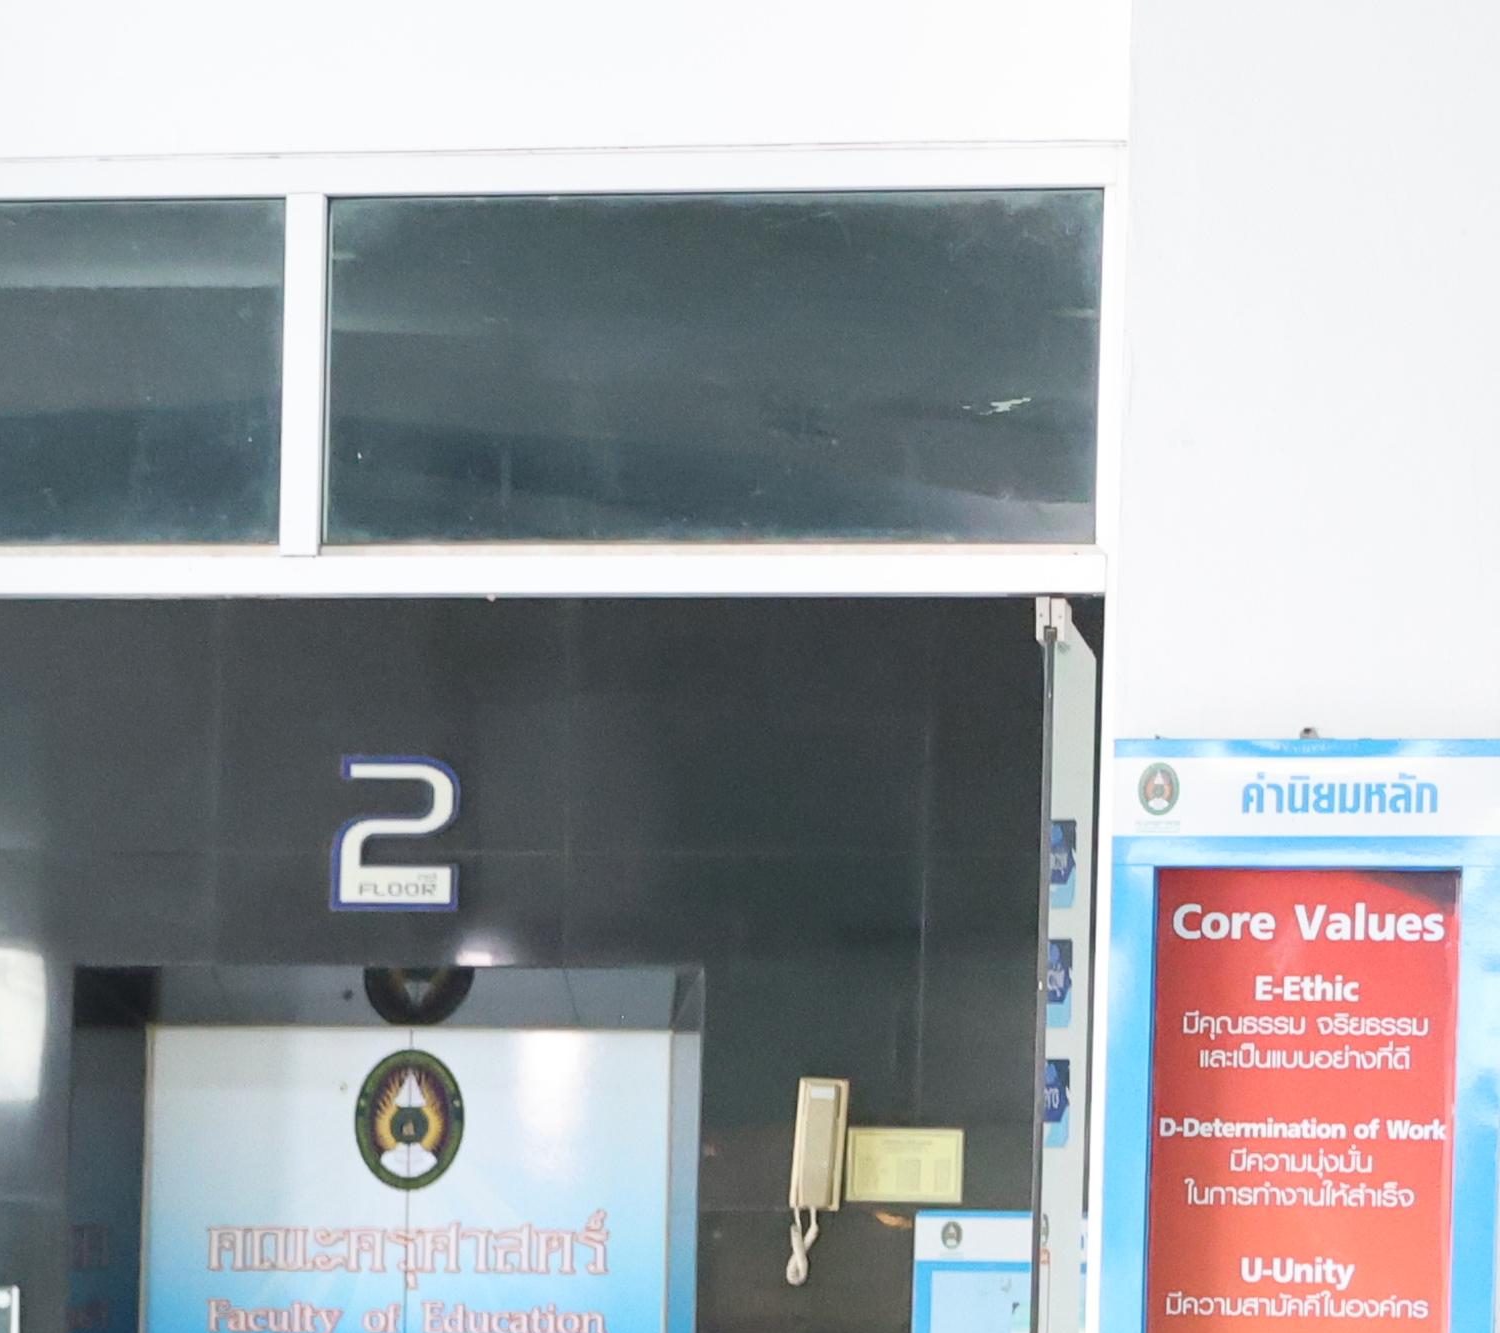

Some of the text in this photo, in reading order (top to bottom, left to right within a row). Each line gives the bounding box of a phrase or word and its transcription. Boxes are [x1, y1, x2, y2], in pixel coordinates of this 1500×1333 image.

[1241, 771, 1438, 814] คำนิยมหลัก
[341, 763, 453, 903] 2
[359, 883, 437, 897] FLOOR
[1172, 902, 1445, 941] Core Values
[1255, 974, 1360, 1002] E-Ethic
[1183, 1011, 1430, 1041] มีคุณธรรม จริยธรรม
[1199, 1040, 1412, 1070] และเป็นแบบอย่างที่ดี
[1159, 1117, 1447, 1141] D-Determination of Work
[1230, 1145, 1373, 1178] มีความมุ่งมั่น
[1184, 1178, 1415, 1208] ในการทำงานให้สำเร็จ
[206, 1209, 610, 1290] คณะครุศาสตร์
[1240, 1257, 1356, 1290] U-Unity
[1165, 1290, 1429, 1320] มีความสามัคคีในองค์กร
